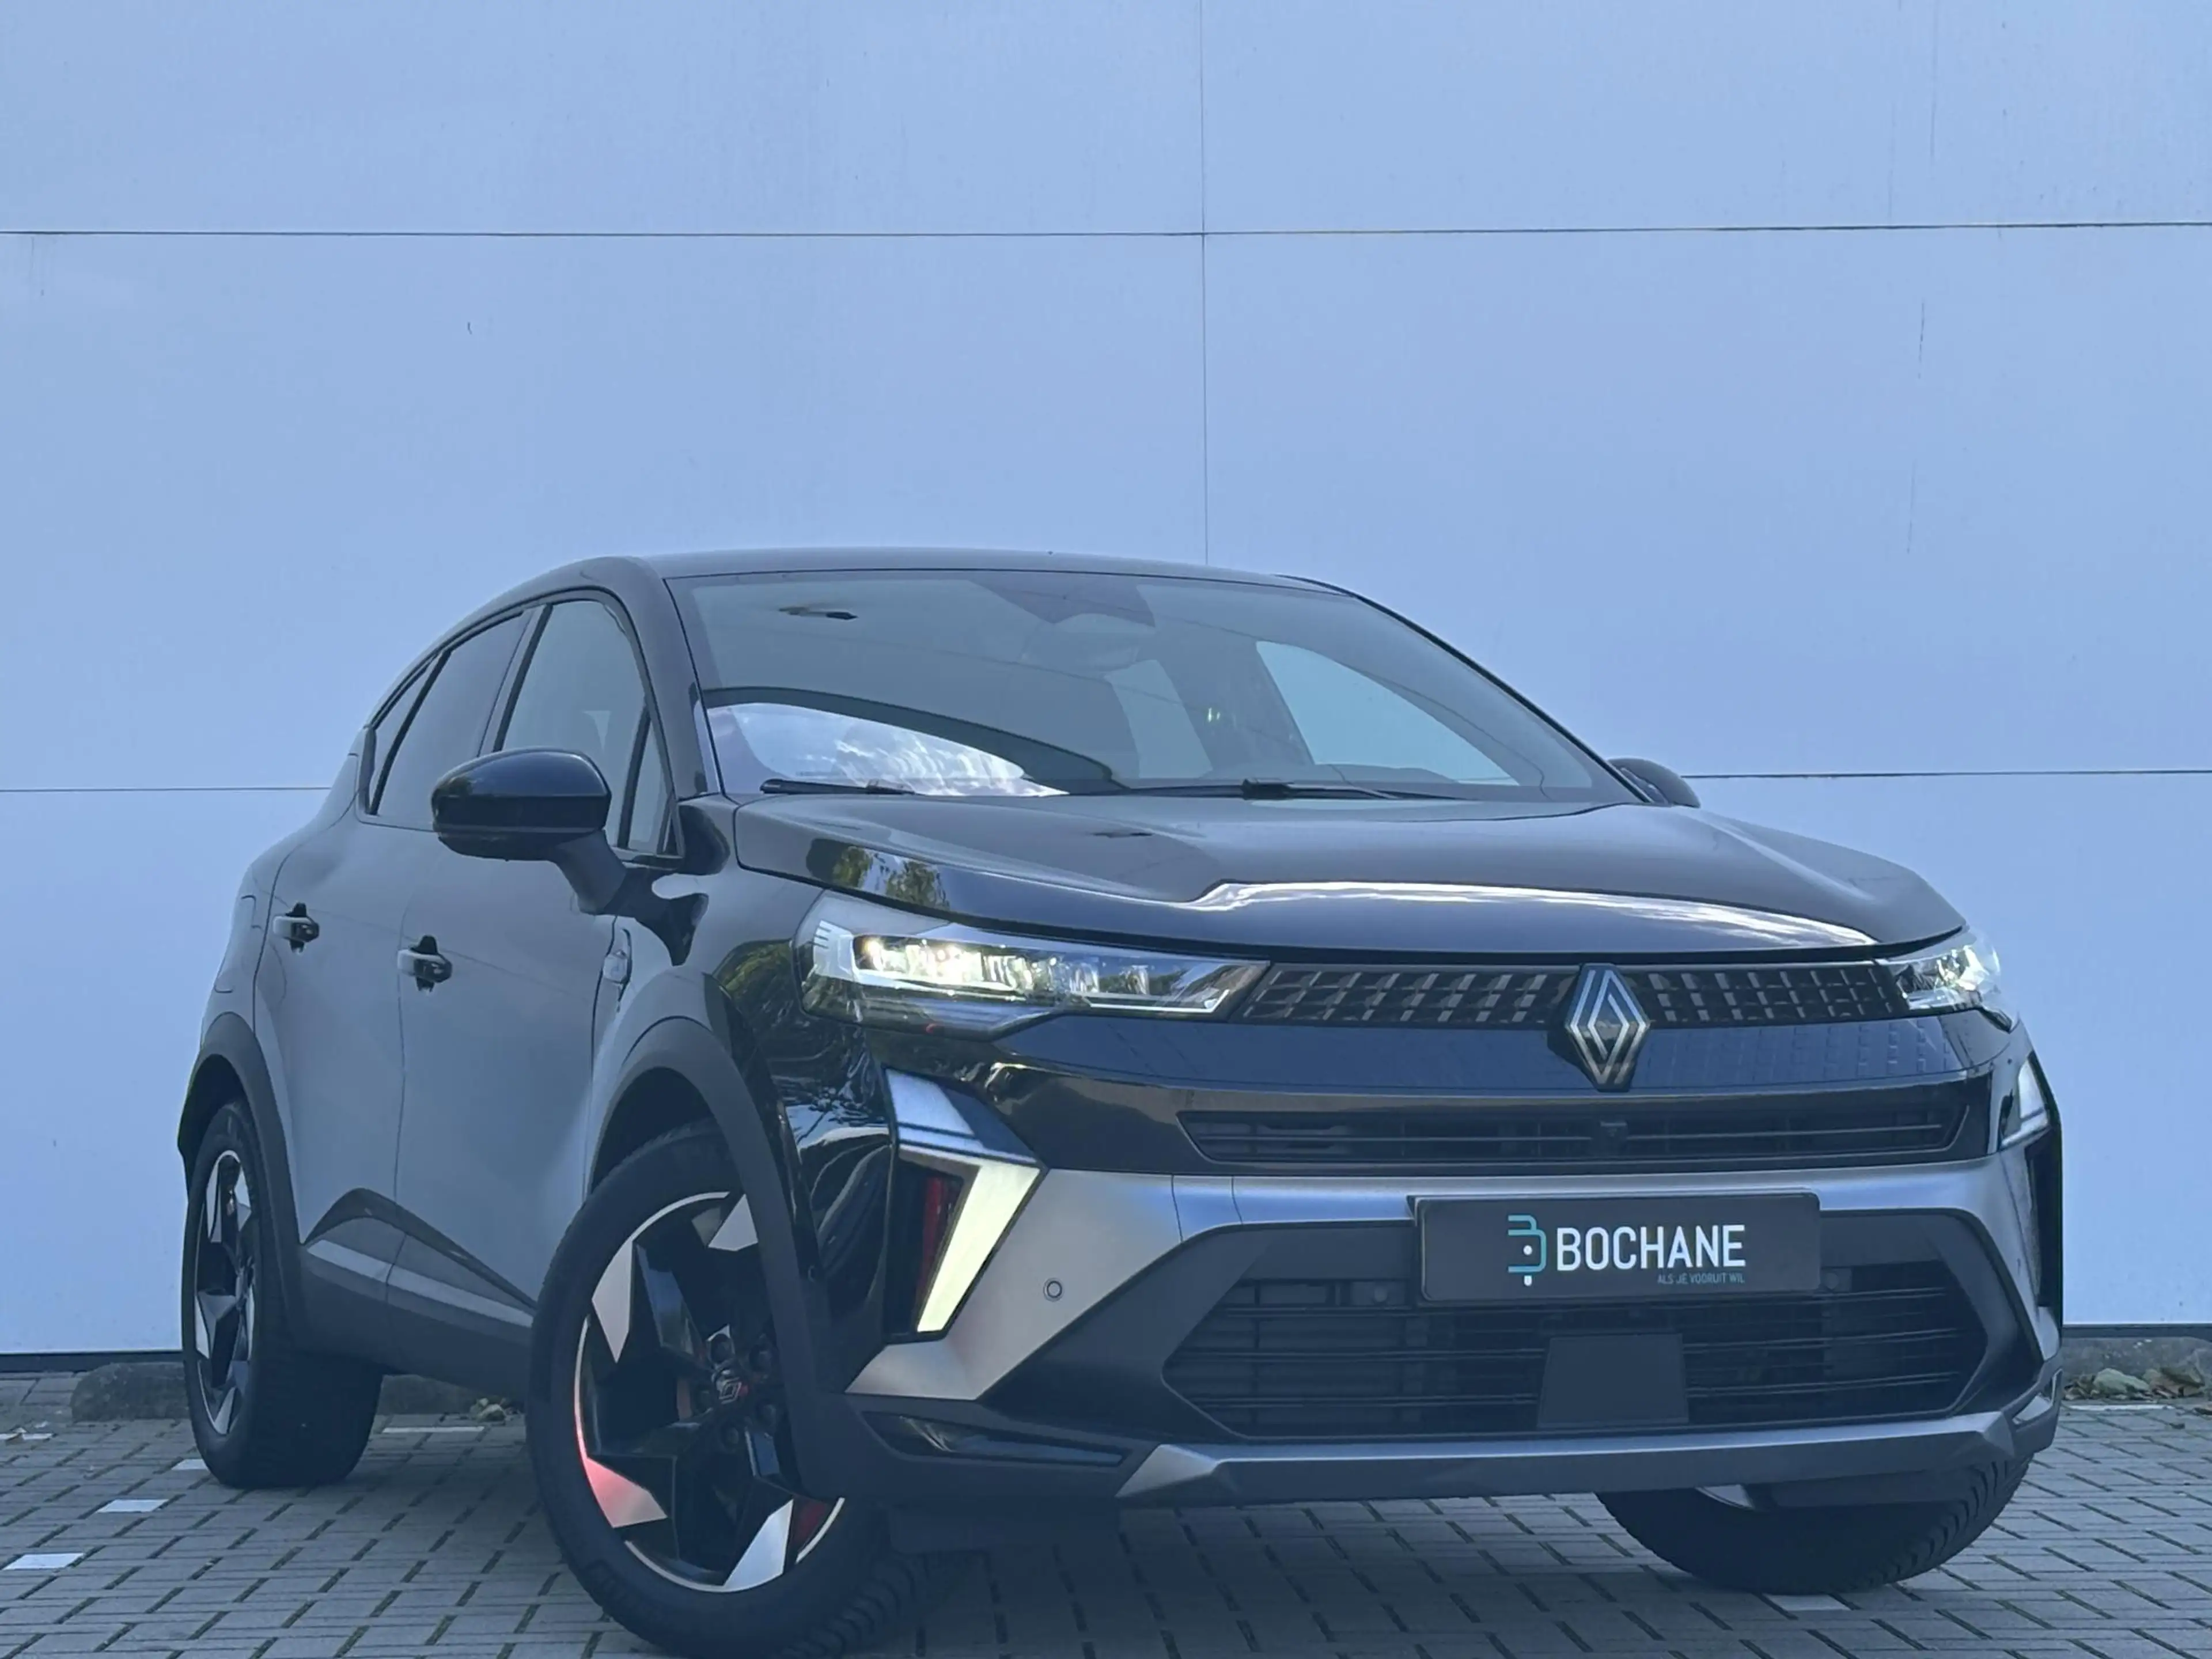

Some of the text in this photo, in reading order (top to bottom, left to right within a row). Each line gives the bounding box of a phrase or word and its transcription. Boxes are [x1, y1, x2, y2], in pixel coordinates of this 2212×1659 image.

[1556, 1224, 1746, 1271] BOCHANE
[1658, 1272, 1745, 1284] ALS JE VOORUIT WIL
